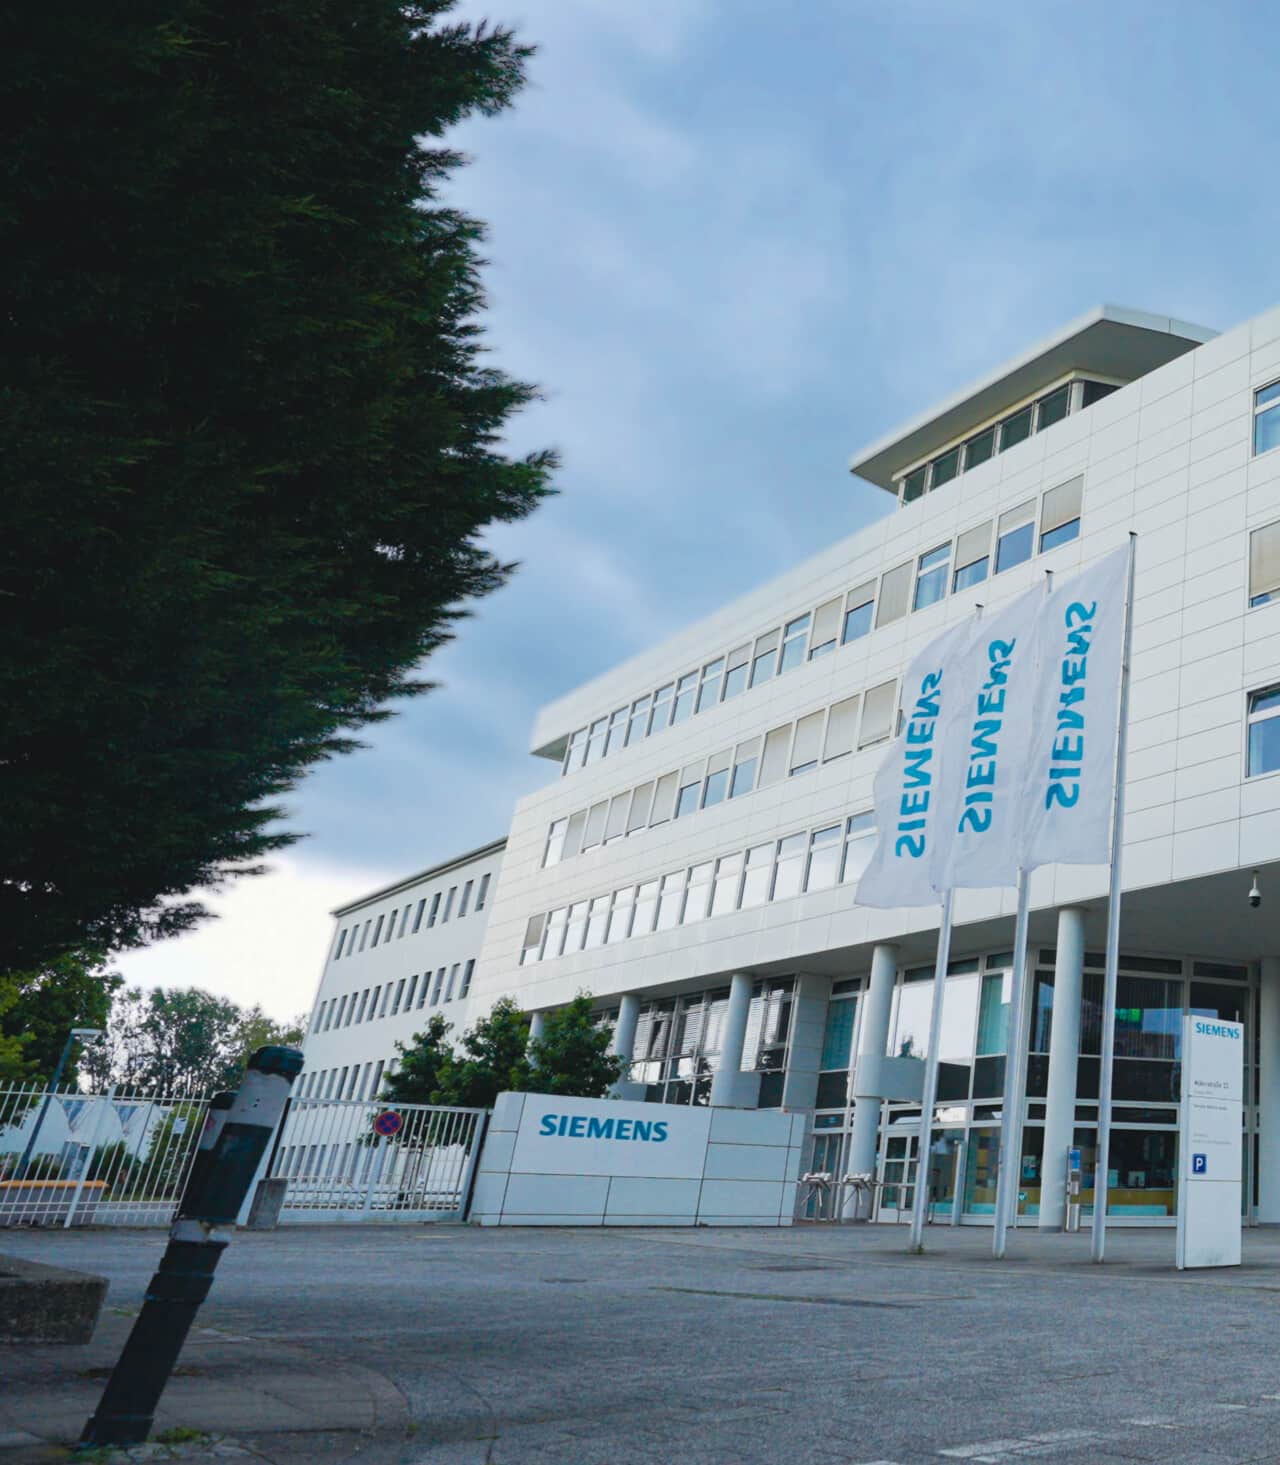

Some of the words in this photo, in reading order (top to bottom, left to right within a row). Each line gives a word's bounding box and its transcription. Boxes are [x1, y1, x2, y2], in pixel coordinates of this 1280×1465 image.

[1195, 1021, 1240, 1040] SIEMENS
[539, 1113, 669, 1143] SIEMENS
[1196, 1157, 1204, 1171] P
